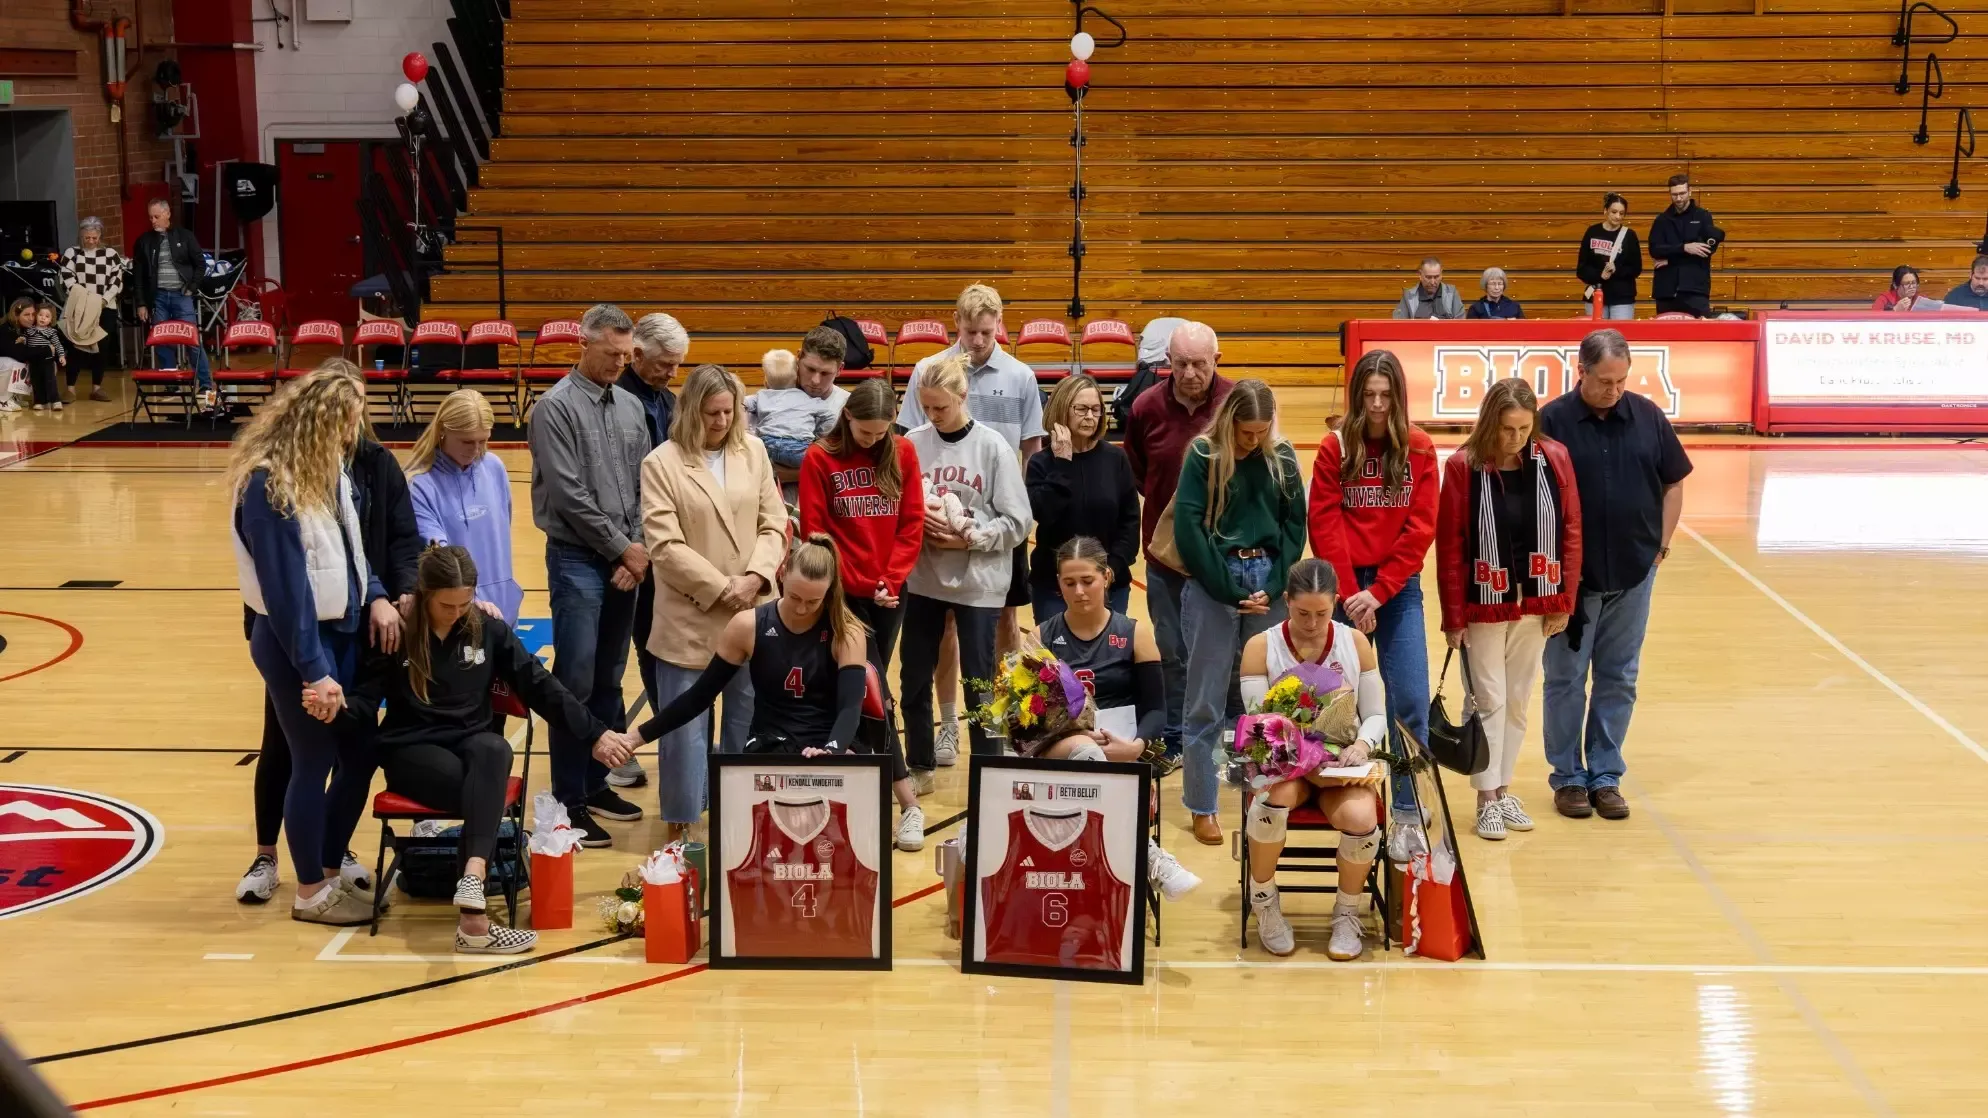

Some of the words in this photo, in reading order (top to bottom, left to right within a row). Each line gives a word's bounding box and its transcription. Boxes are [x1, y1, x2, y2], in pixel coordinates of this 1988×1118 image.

[154, 323, 193, 337] BIOLA
[231, 323, 270, 337] BIOLA
[299, 323, 338, 337] BIOLA
[360, 323, 398, 337] BIOLA
[417, 322, 456, 337] BIOLA
[472, 322, 511, 337] BIOLA
[542, 322, 580, 336] BIOLA
[1087, 321, 1128, 336] BIOLA
[1775, 332, 1835, 345] DAVID
[1841, 332, 1864, 345] W.
[1868, 332, 1941, 347] KRUSE,
[1945, 332, 1976, 345] MD
[831, 466, 877, 495] BIO
[922, 465, 983, 496] IOLA
[1342, 485, 1413, 508] NIVERSITY
[834, 494, 900, 518] UNIVERSIT
[1529, 552, 1561, 585] BU
[1475, 559, 1509, 594] BU
[1109, 634, 1127, 648] BU
[784, 667, 805, 698] 4
[788, 778, 810, 786] KENDALL
[1060, 787, 1076, 797] BETH
[1077, 788, 1098, 798] BELLFI
[773, 863, 834, 880] BIOLA
[1025, 871, 1086, 890] BIOLA
[792, 884, 817, 918] 4
[1042, 892, 1069, 928] 6
